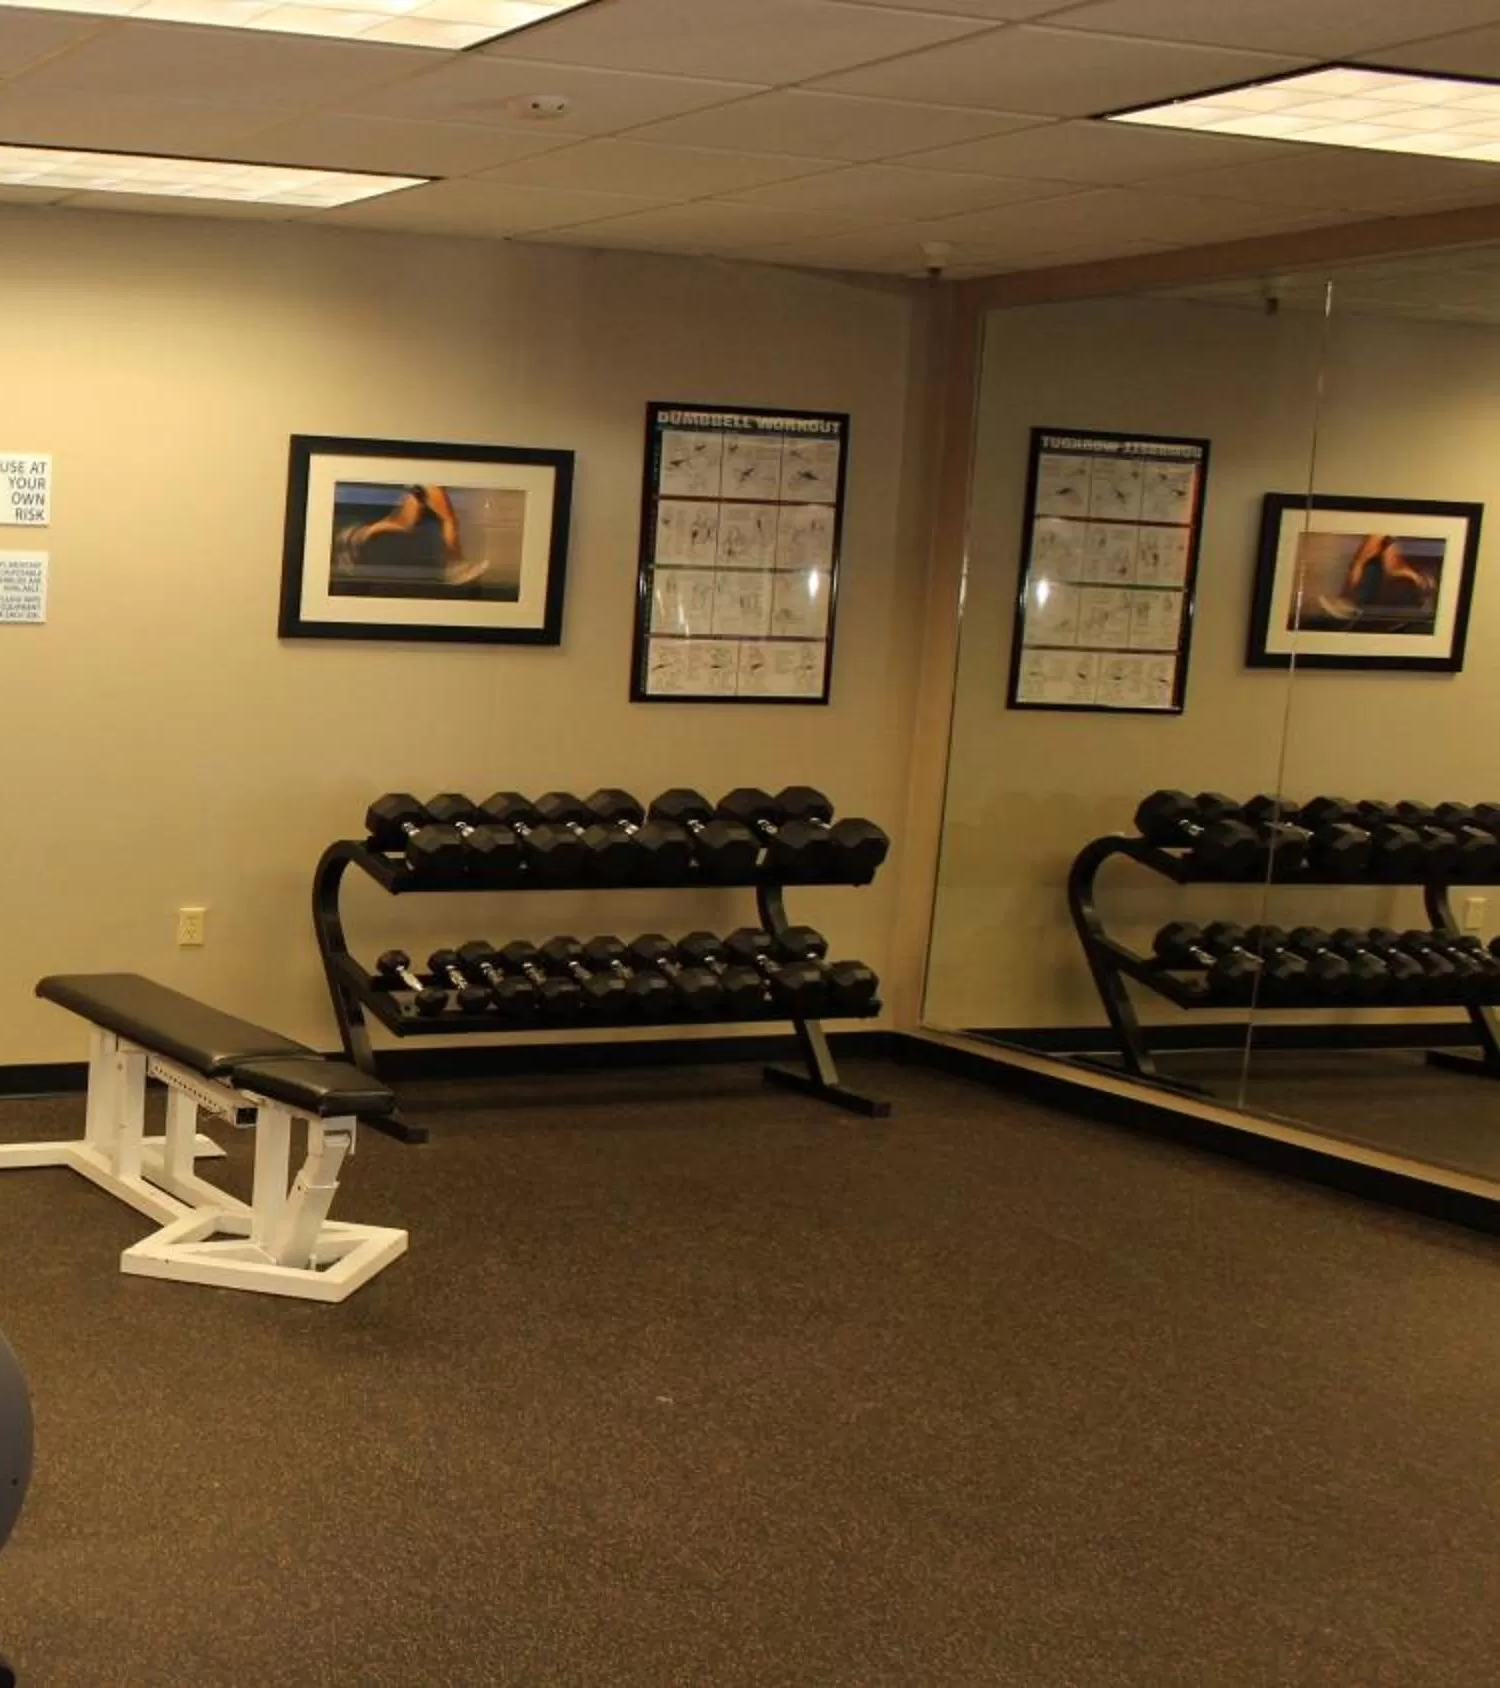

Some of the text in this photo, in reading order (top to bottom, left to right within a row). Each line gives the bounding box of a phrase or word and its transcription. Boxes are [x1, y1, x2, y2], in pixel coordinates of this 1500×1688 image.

[0, 460, 47, 475] USE AT
[8, 476, 46, 490] YOUR
[11, 491, 45, 505] OWN
[15, 507, 45, 521] RISK
